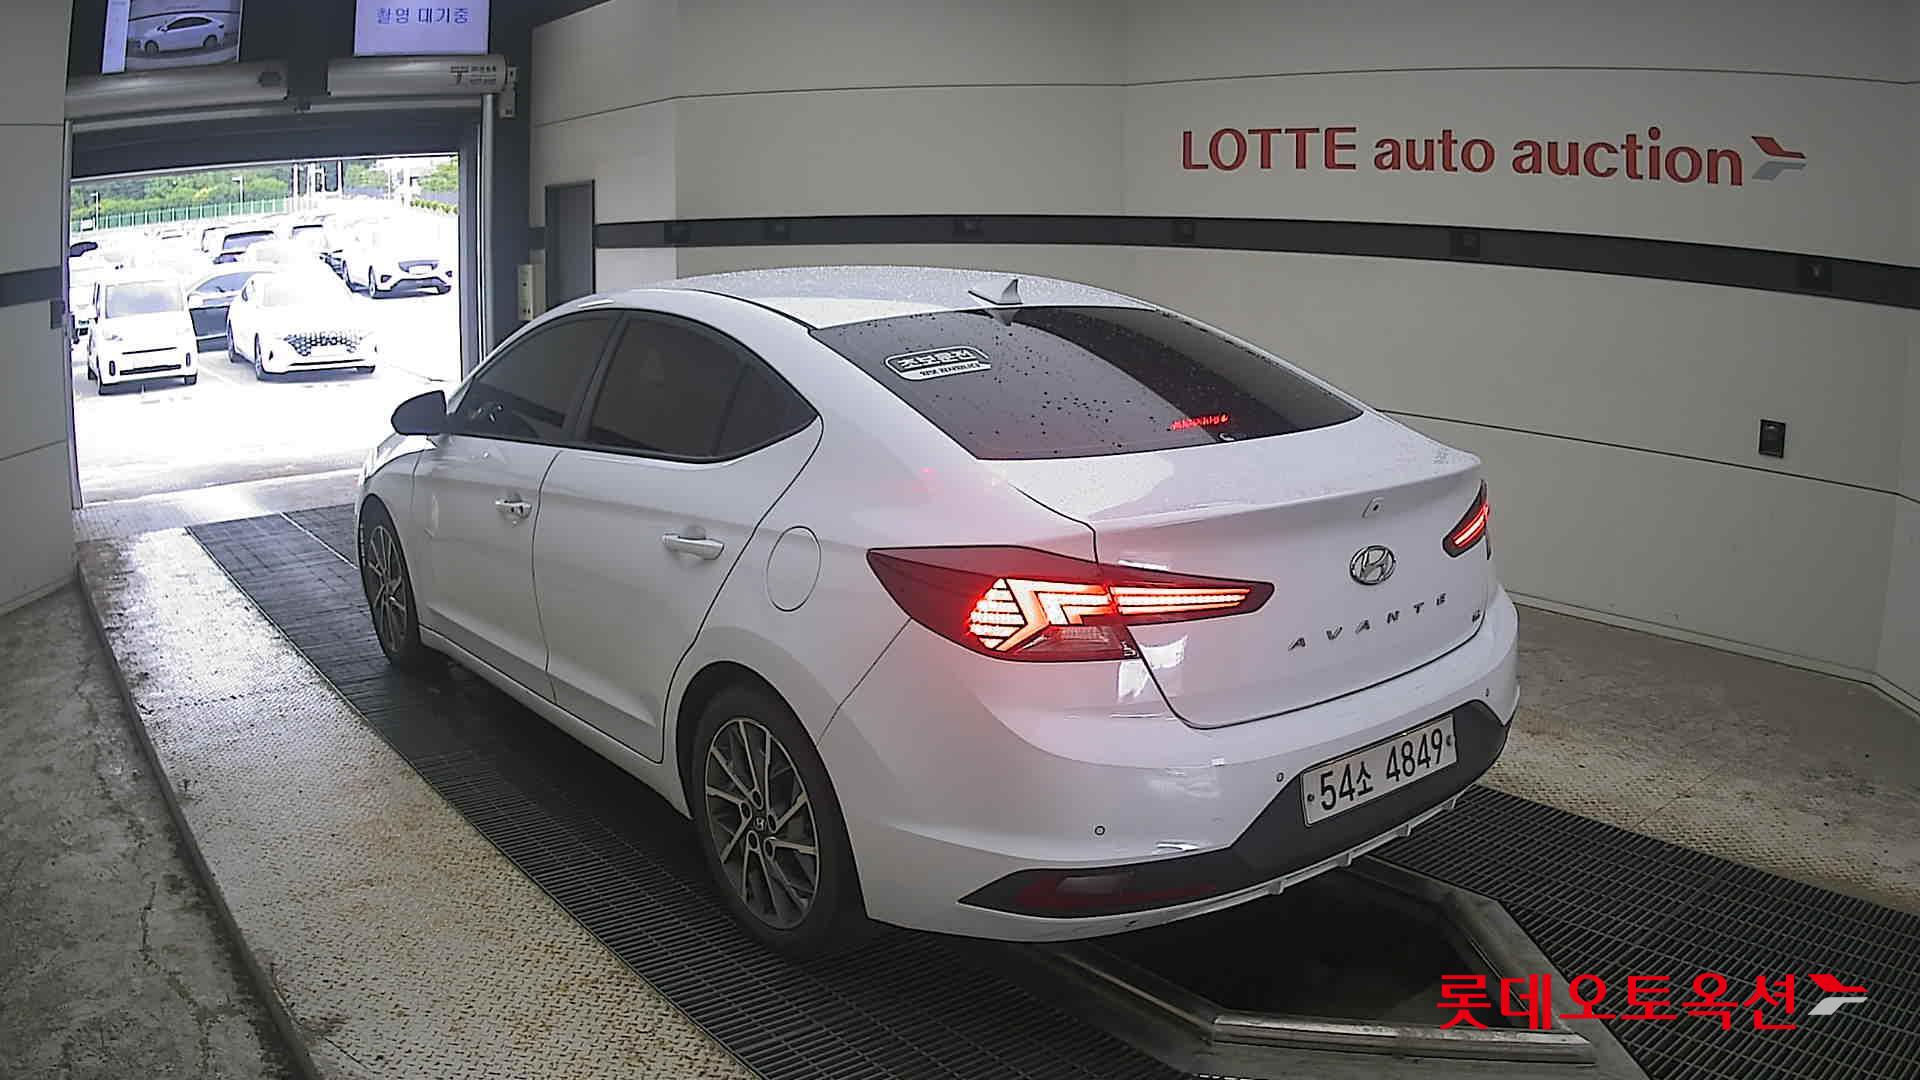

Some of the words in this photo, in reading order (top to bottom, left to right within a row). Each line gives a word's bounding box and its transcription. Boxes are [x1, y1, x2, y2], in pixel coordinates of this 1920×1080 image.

[418, 7, 469, 24] 대기중
[1182, 127, 1357, 171] LOTTE
[1374, 130, 1495, 173] auto
[1512, 127, 1743, 186] auction
[1288, 593, 1447, 651] AVANTE
[1320, 761, 1373, 810] 54소
[1386, 728, 1443, 782] 4849
